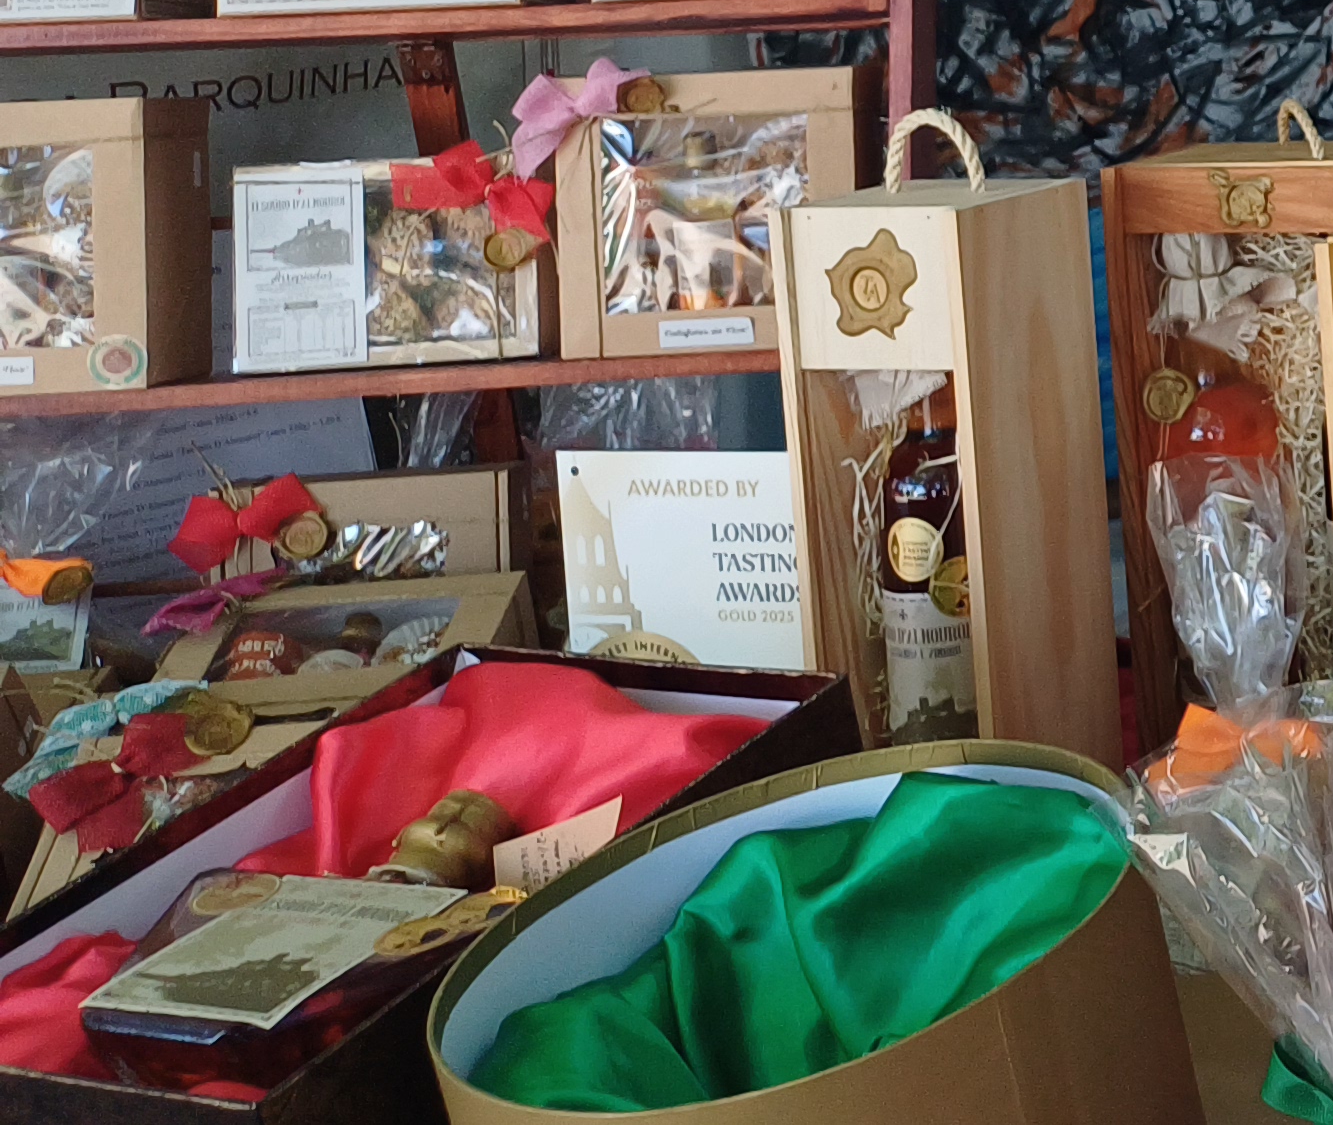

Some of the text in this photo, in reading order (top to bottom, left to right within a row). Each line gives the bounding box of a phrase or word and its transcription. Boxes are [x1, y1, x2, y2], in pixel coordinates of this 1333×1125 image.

[626, 478, 760, 498] AWARDED BY
[717, 609, 795, 623] GOLD 2025
